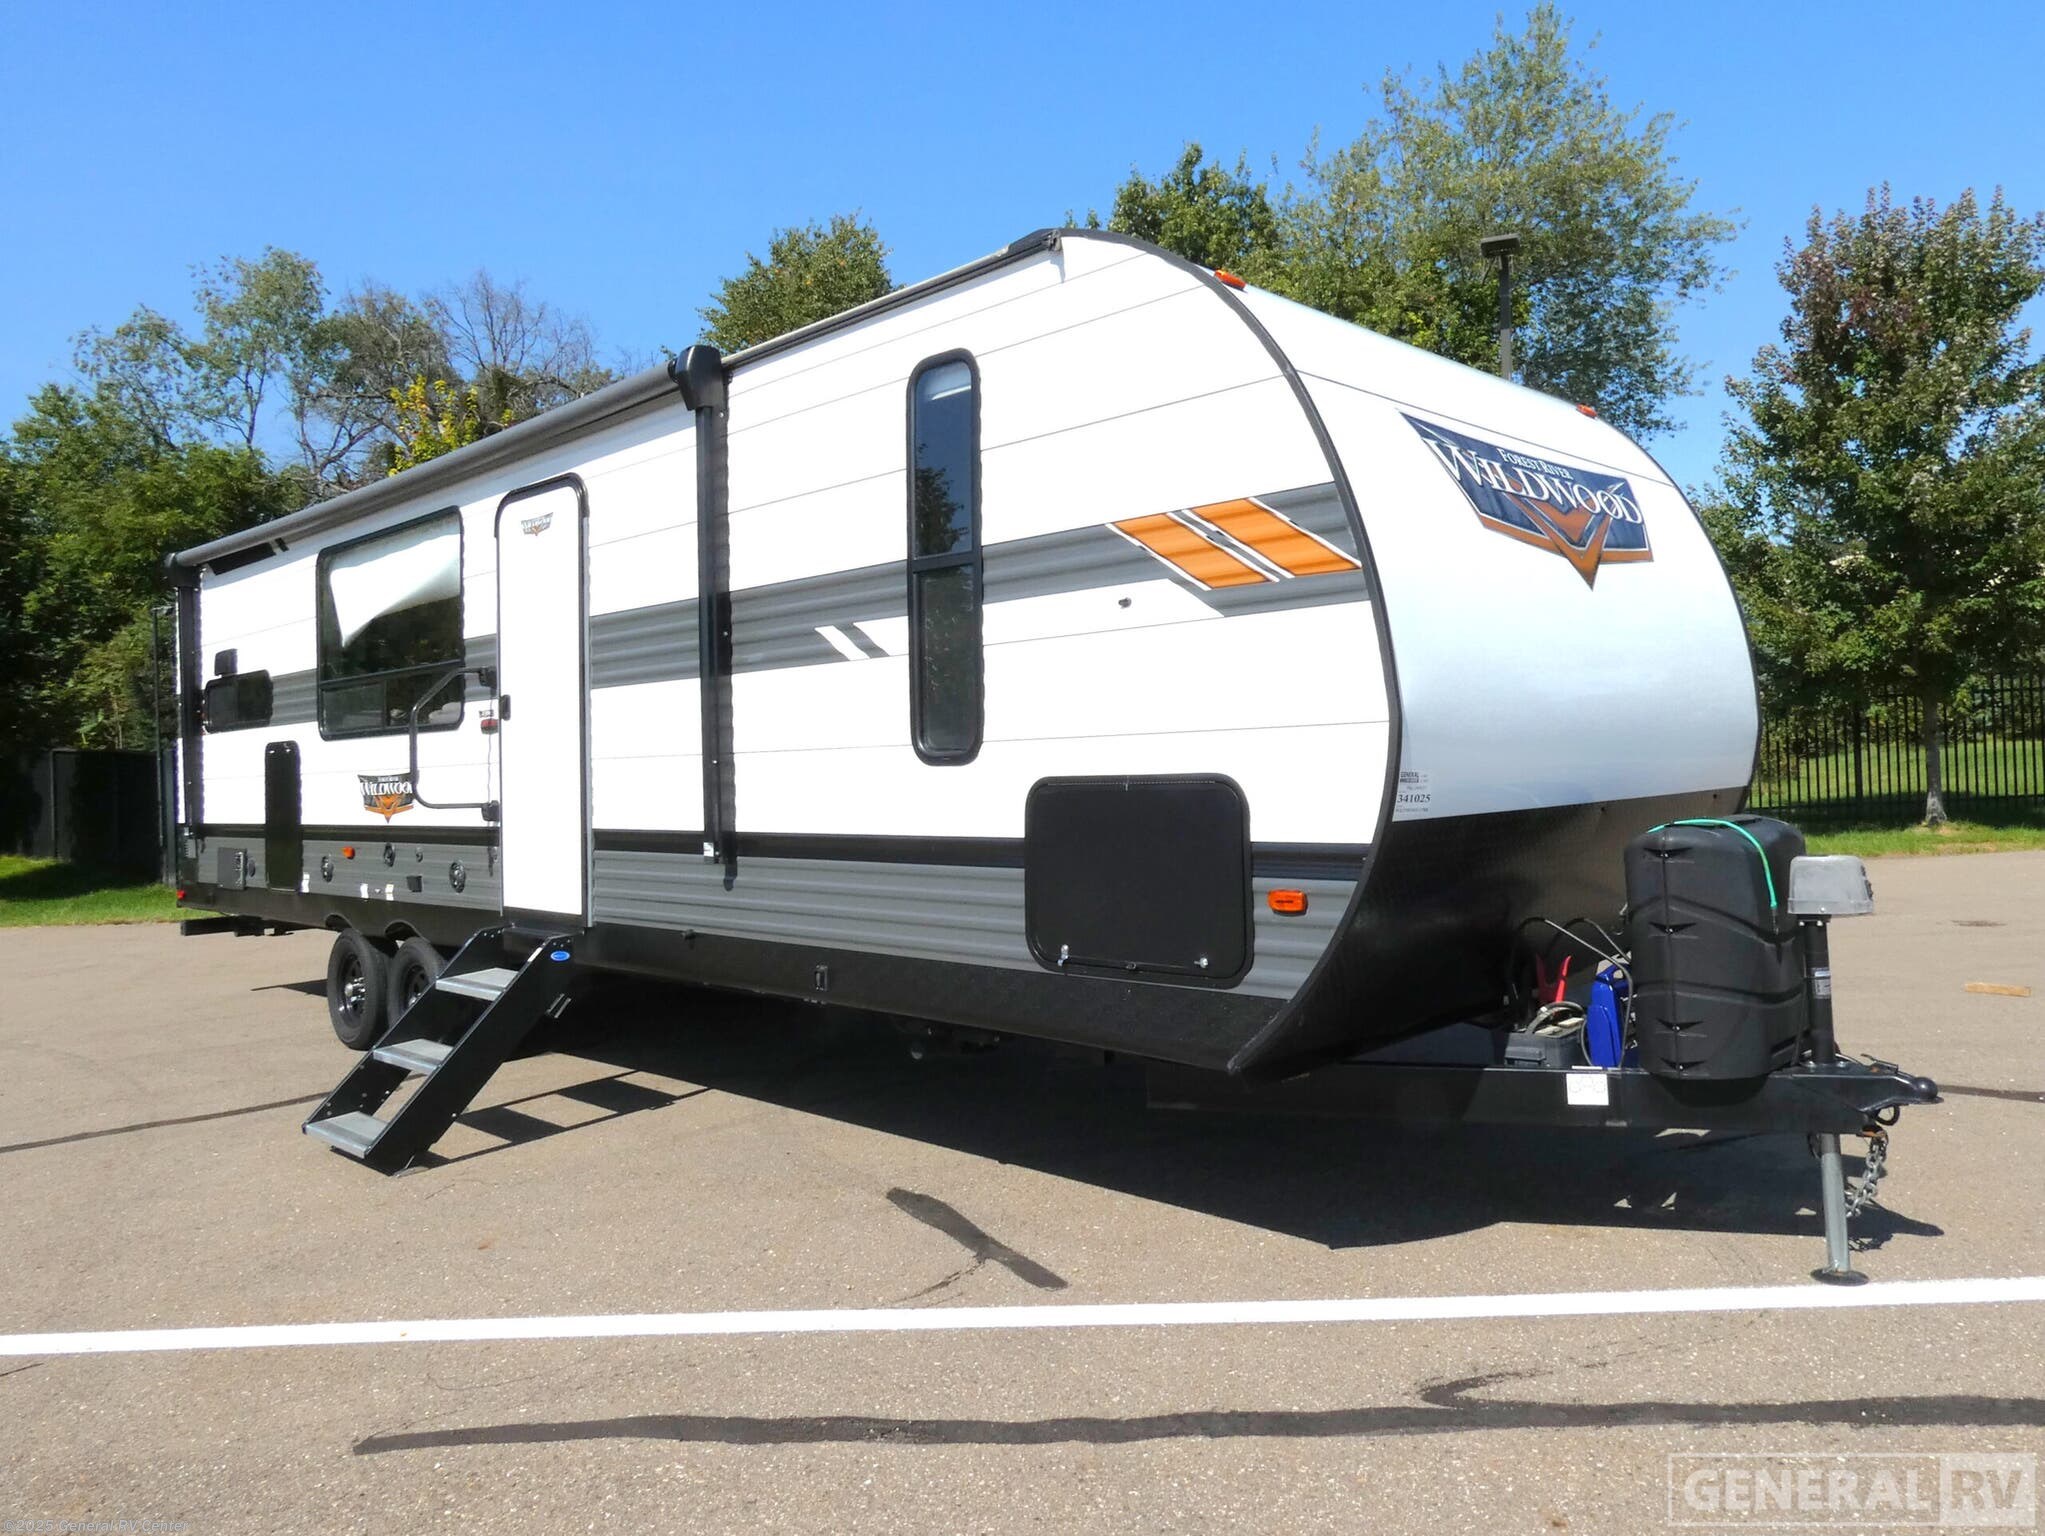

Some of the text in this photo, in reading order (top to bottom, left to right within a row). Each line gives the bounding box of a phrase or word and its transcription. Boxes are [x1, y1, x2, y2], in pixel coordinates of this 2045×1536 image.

[1496, 448, 1573, 479] FOREST RIVER
[1421, 437, 1643, 524] WILDWOOD
[1397, 793, 1431, 803] 341025
